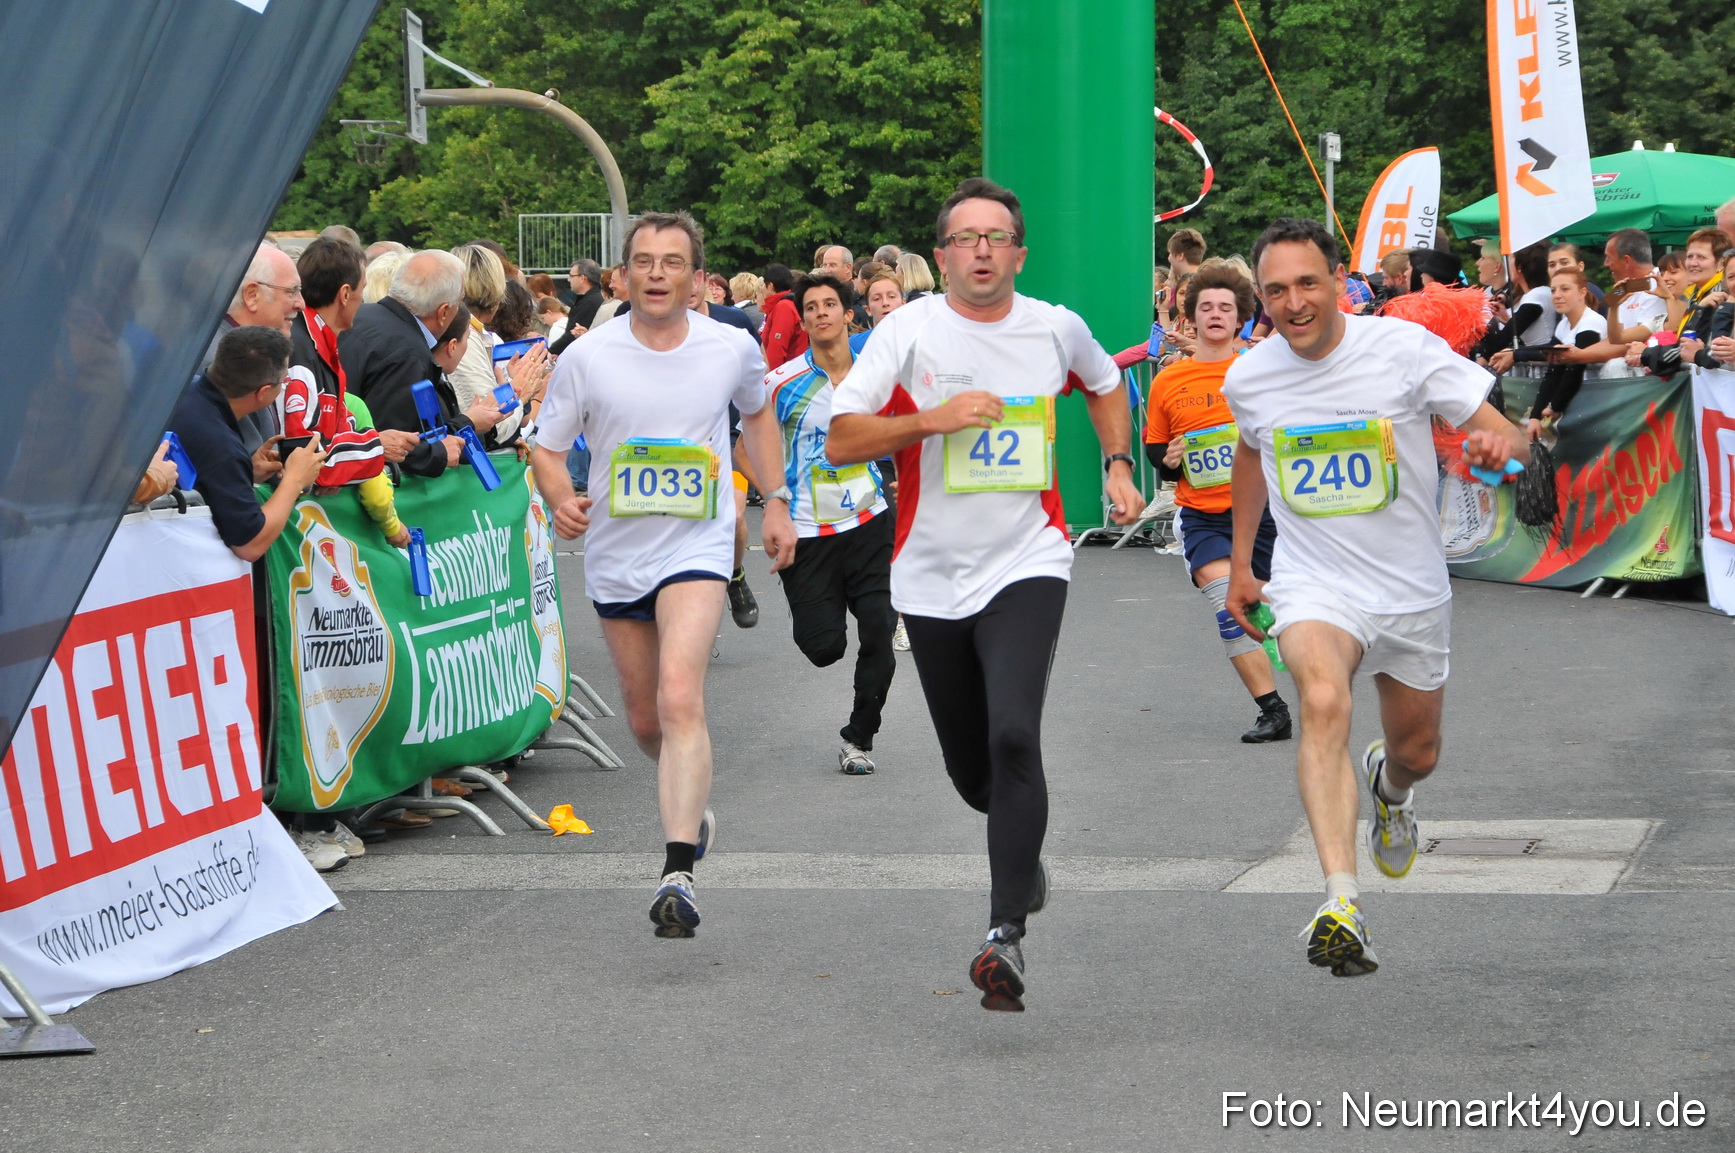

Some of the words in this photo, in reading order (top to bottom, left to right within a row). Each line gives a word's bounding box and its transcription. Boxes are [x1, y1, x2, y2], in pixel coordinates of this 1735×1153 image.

[1513, 0, 1544, 122] KLE
[1376, 186, 1413, 262] BL
[969, 429, 1021, 467] 42
[1188, 444, 1234, 474] 568
[617, 467, 703, 498] 1033
[969, 468, 1007, 478] Stephan
[1291, 452, 1372, 495] 240
[625, 500, 656, 509] Jürgen
[840, 489, 855, 511] 4
[1309, 493, 1344, 504] Sascha
[398, 597, 536, 745] Lammsbräu
